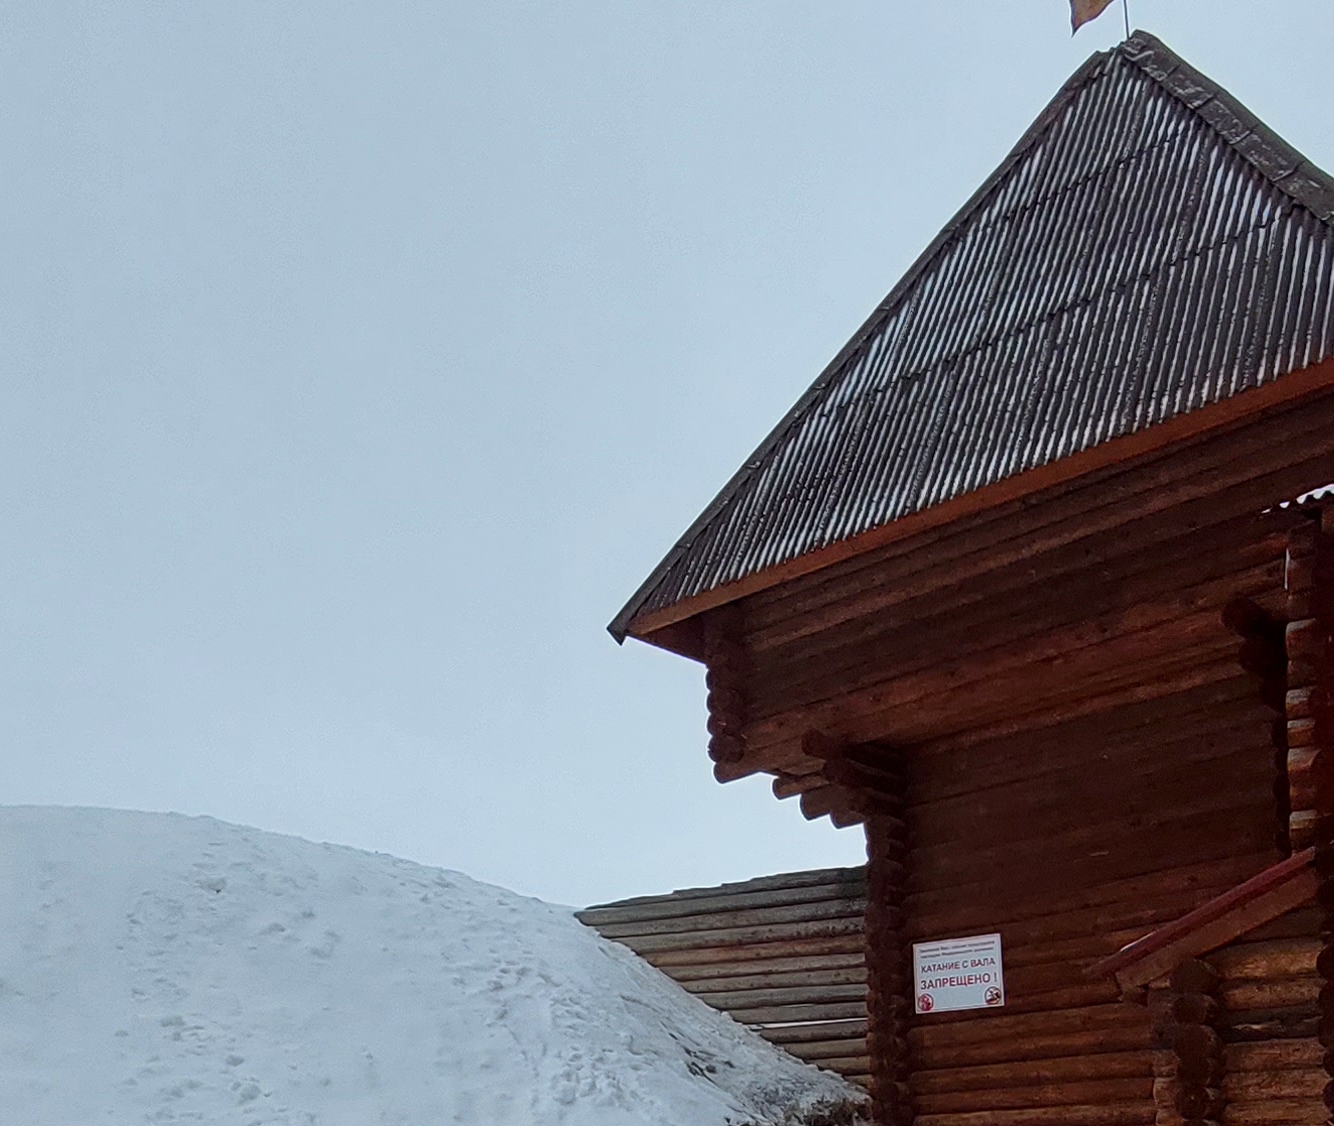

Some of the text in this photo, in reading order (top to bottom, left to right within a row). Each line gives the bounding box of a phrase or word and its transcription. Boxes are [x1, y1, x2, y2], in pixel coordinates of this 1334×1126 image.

[920, 957, 996, 973] КАТАНИЕ С ВАЛА
[920, 973, 991, 990] ЗАПРЕЩЕНО
